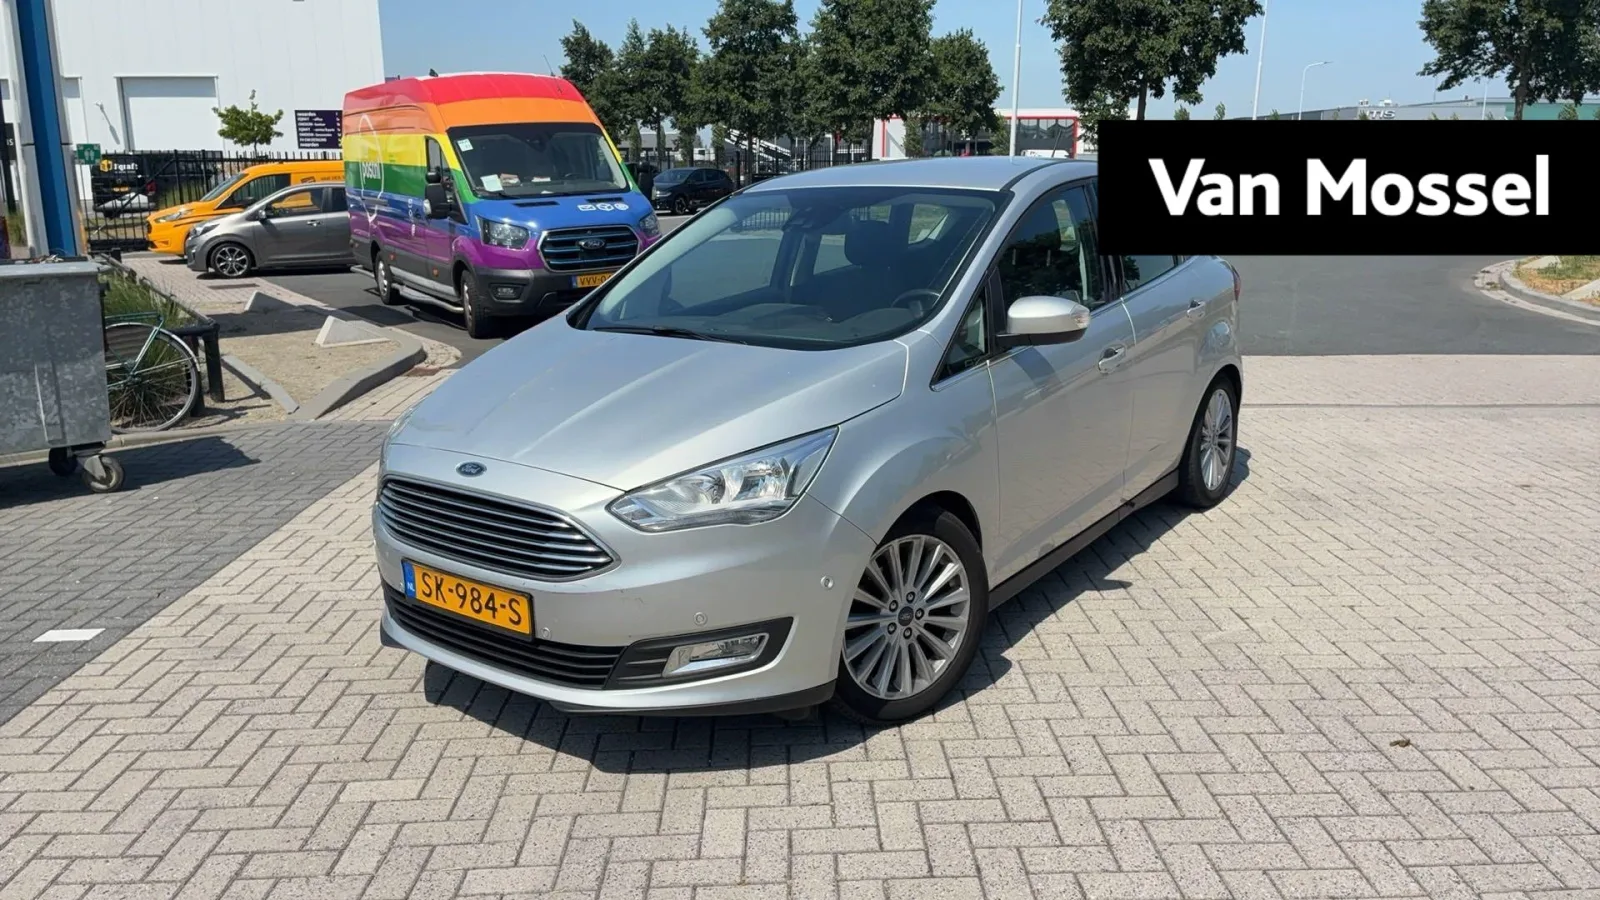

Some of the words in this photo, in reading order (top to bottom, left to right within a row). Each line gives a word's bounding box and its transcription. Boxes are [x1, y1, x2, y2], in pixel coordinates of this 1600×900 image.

[461, 463, 481, 474] Ford
[407, 581, 415, 592] NL
[421, 571, 523, 627] SK-984-S
